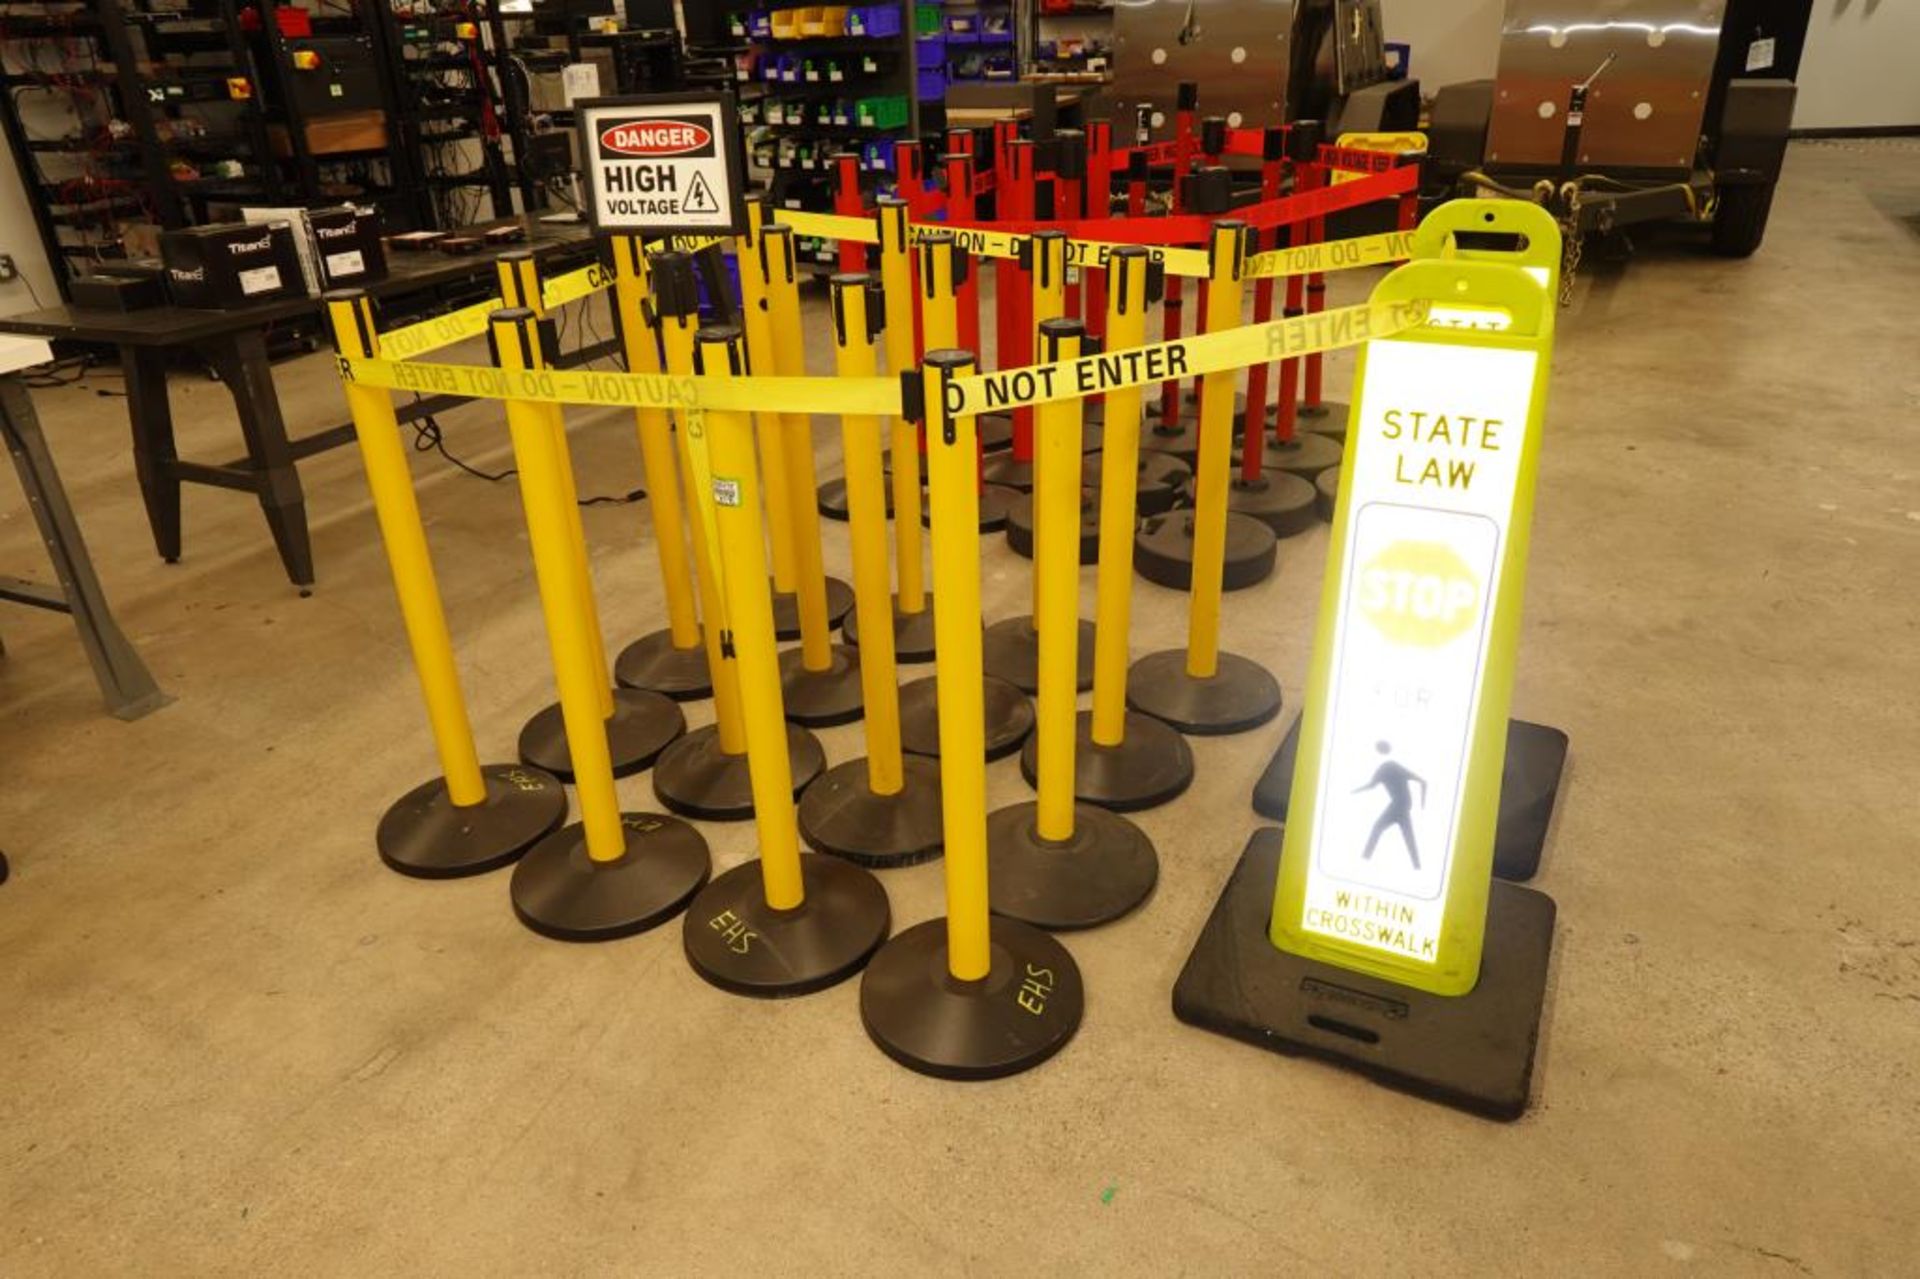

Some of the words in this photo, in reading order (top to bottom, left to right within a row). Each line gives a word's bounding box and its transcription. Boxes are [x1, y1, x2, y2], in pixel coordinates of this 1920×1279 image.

[614, 128, 696, 148] DANGER
[604, 164, 676, 193] HIGH
[607, 199, 680, 215] VOLTAGE
[984, 366, 1057, 407] NOT
[1076, 344, 1188, 392] ENTER
[1381, 409, 1504, 451] STATE
[1395, 453, 1476, 490] LAW
[1360, 569, 1475, 623] STOP
[1336, 890, 1415, 925] WITHIN
[709, 910, 757, 955] EHS
[1306, 907, 1435, 958] CROSSWALK
[1017, 963, 1054, 1016] EHS
